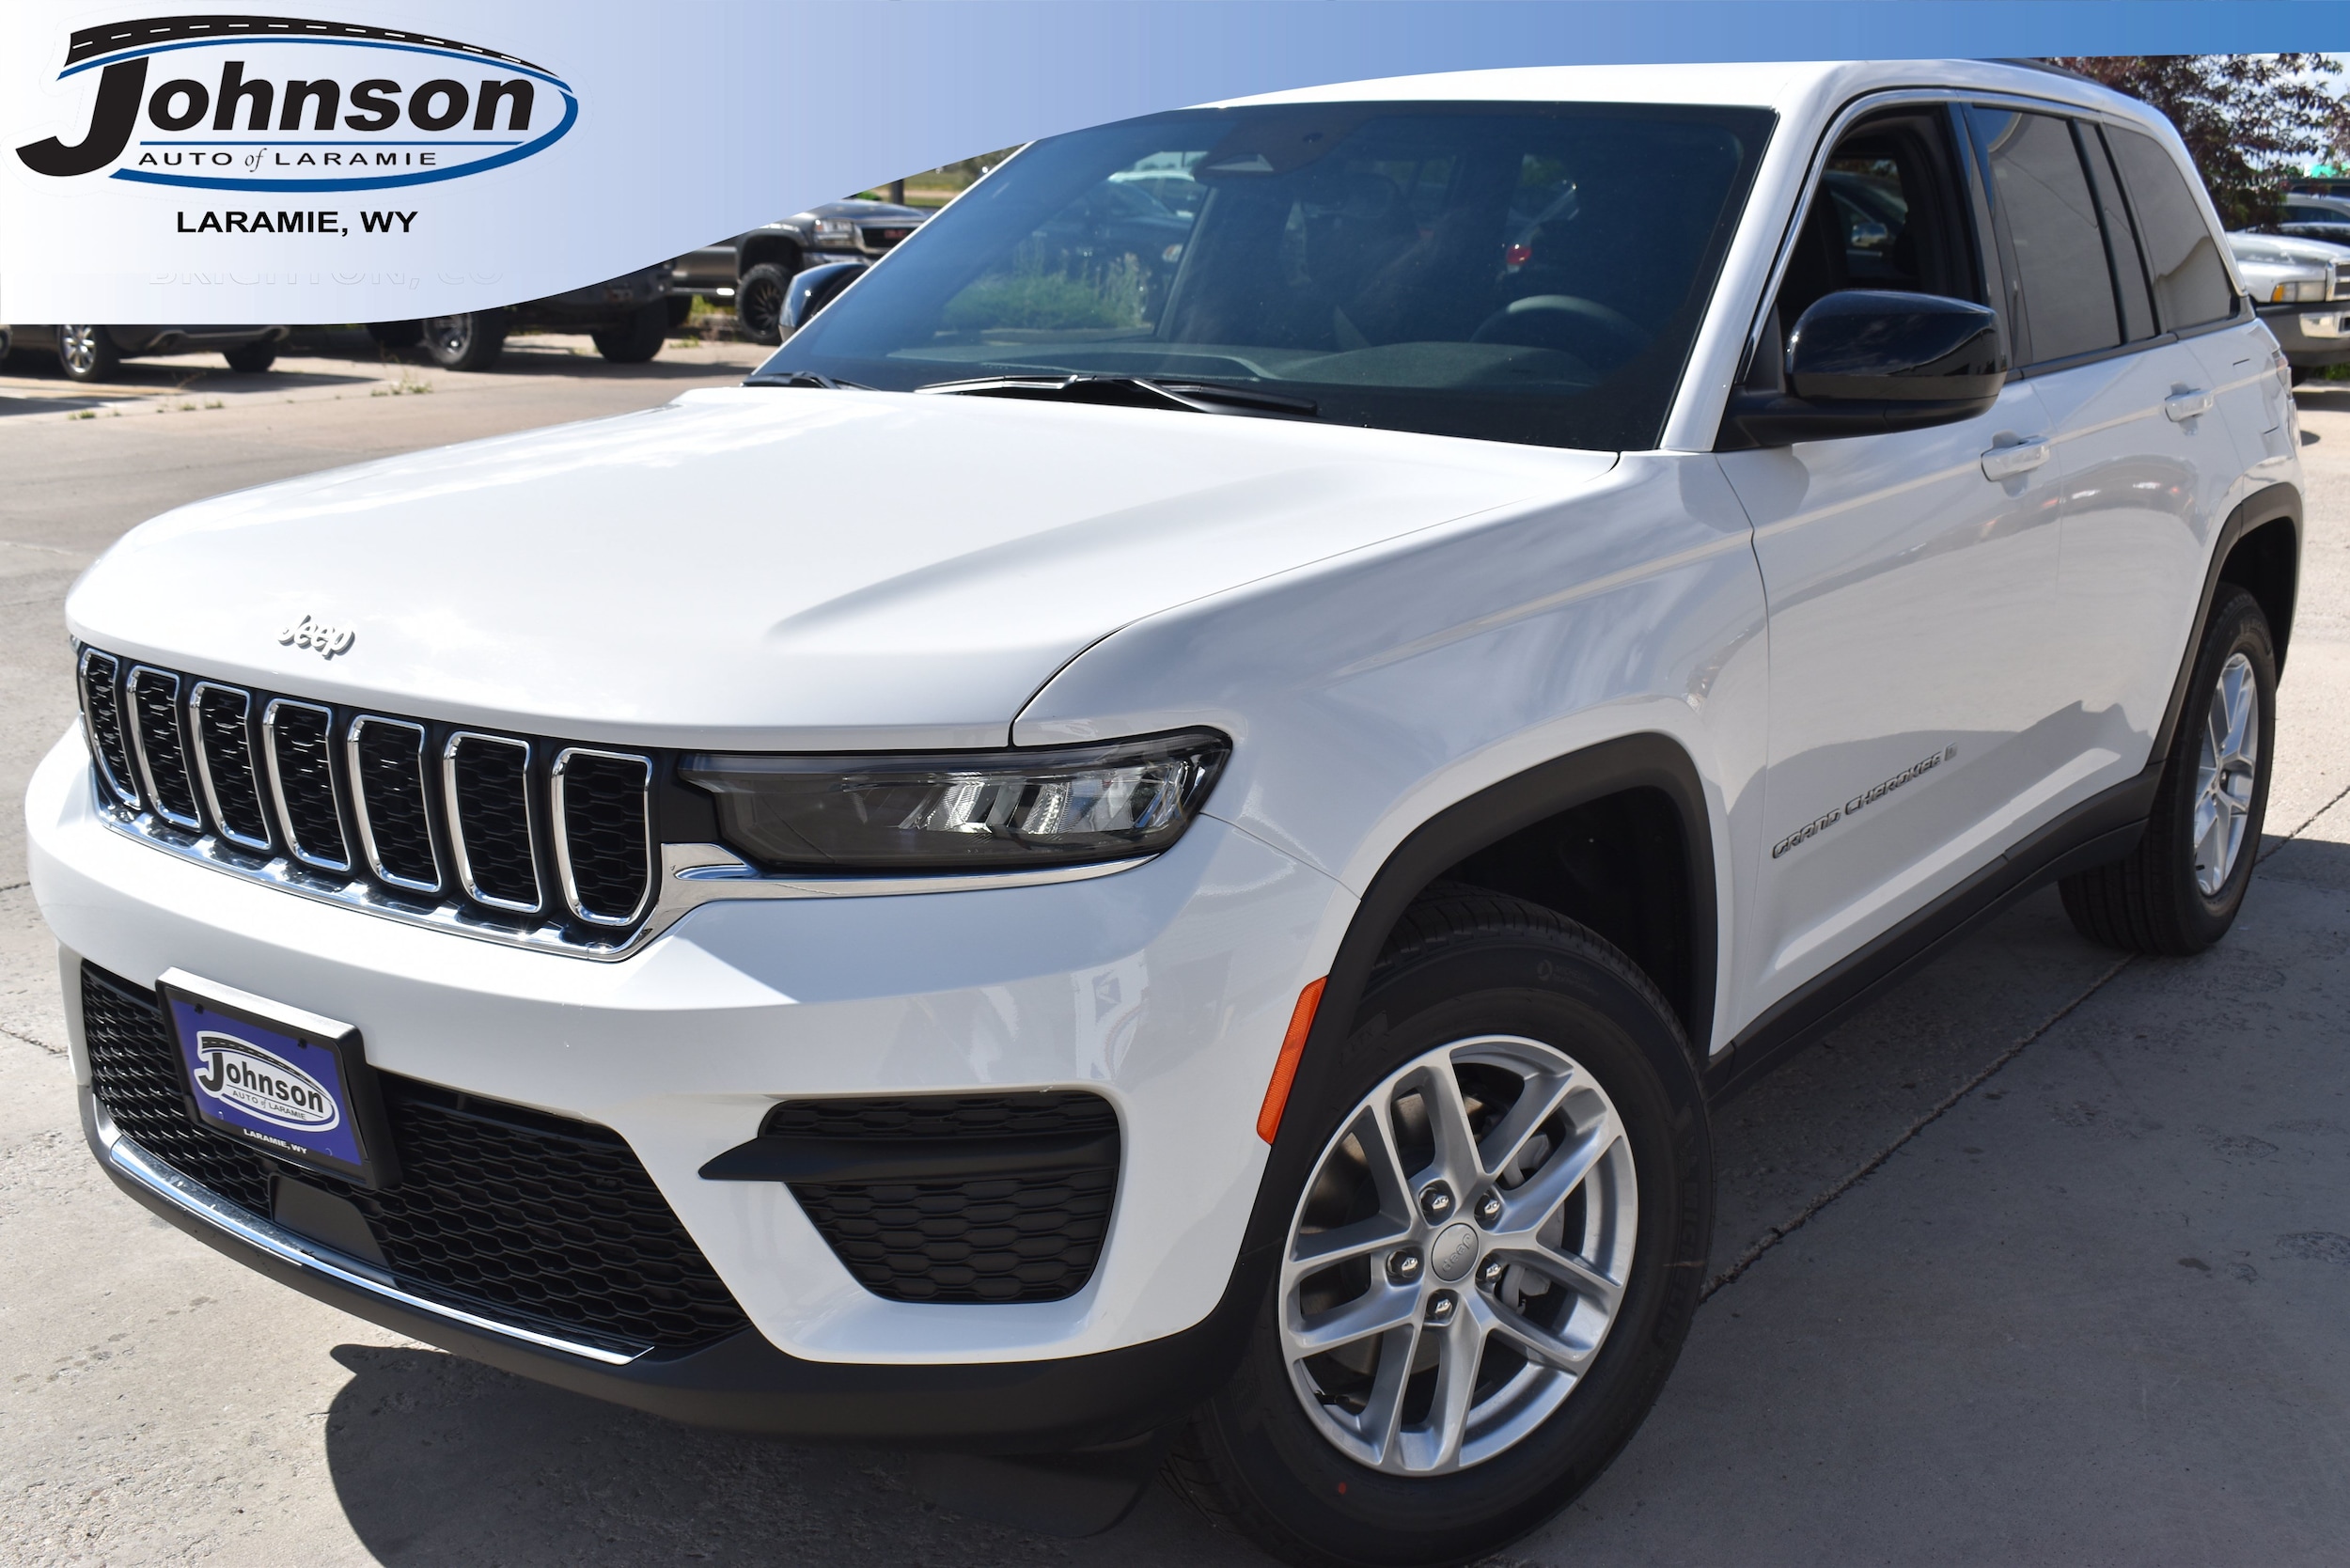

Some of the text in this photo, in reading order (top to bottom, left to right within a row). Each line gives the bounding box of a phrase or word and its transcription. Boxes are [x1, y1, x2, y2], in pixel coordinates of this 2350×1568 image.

[276, 614, 355, 661] Jeep
[1772, 751, 1942, 859] GRAND CHEROKEE
[198, 1052, 324, 1114] Johnson
[232, 1090, 307, 1121] AUTO of LARAMIE
[243, 1128, 307, 1154] LARAMIE, WY
[1442, 1232, 1472, 1272] Jeep
